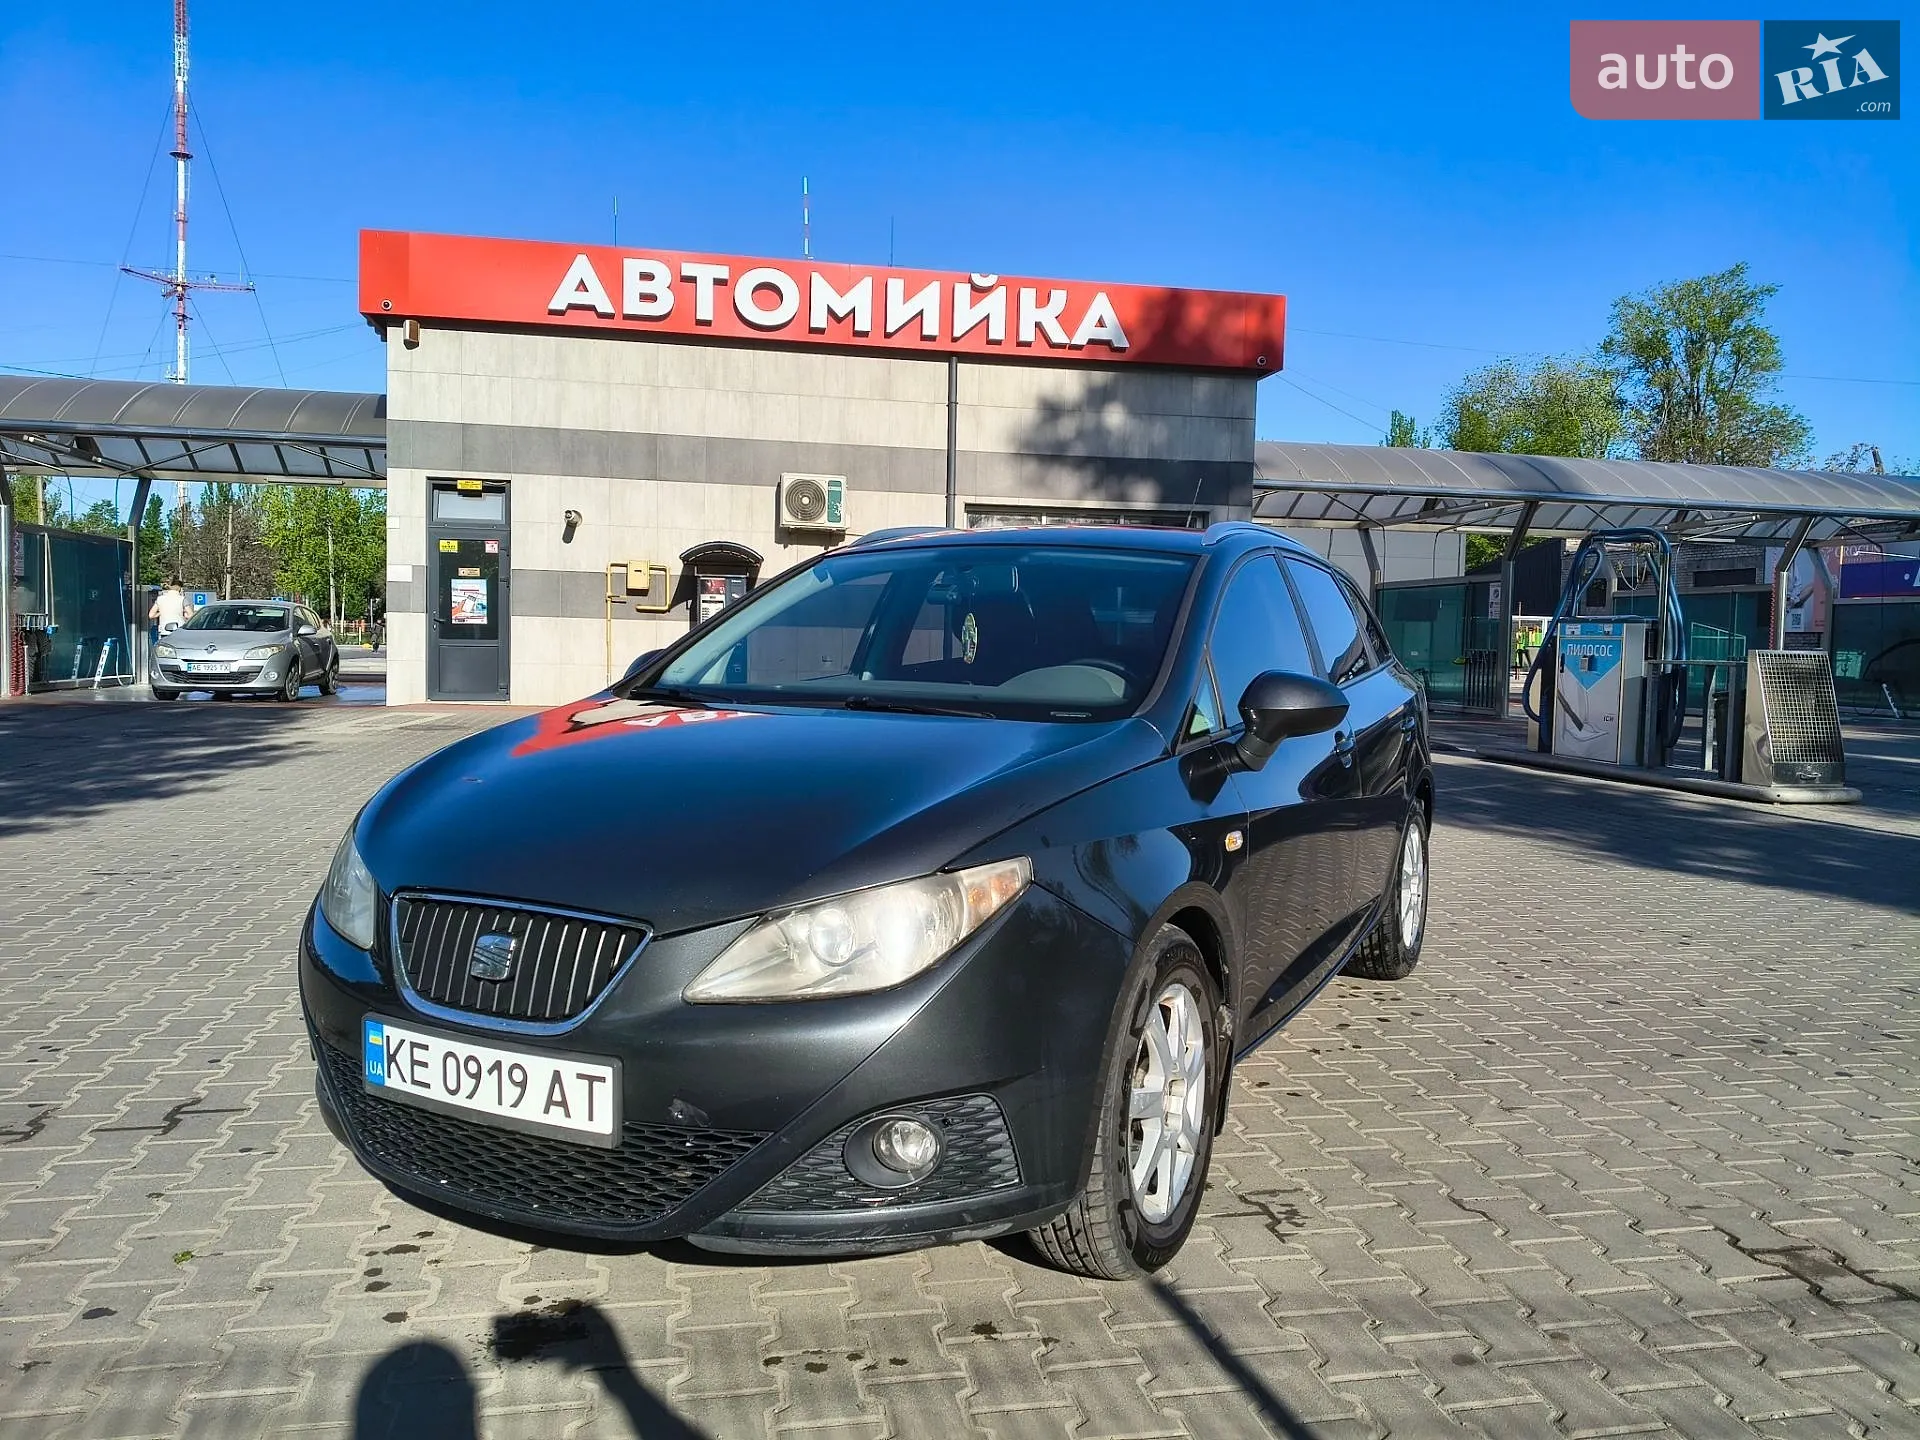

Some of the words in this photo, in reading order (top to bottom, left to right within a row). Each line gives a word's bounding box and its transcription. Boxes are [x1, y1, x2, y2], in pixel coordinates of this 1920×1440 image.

[547, 251, 1130, 352] АВТОМИЙКА
[1566, 643, 1614, 657] ПИЛОСОС
[369, 1060, 383, 1077] UA
[385, 1034, 431, 1090] KE
[442, 1050, 528, 1109] 0919
[543, 1069, 606, 1122] AT
